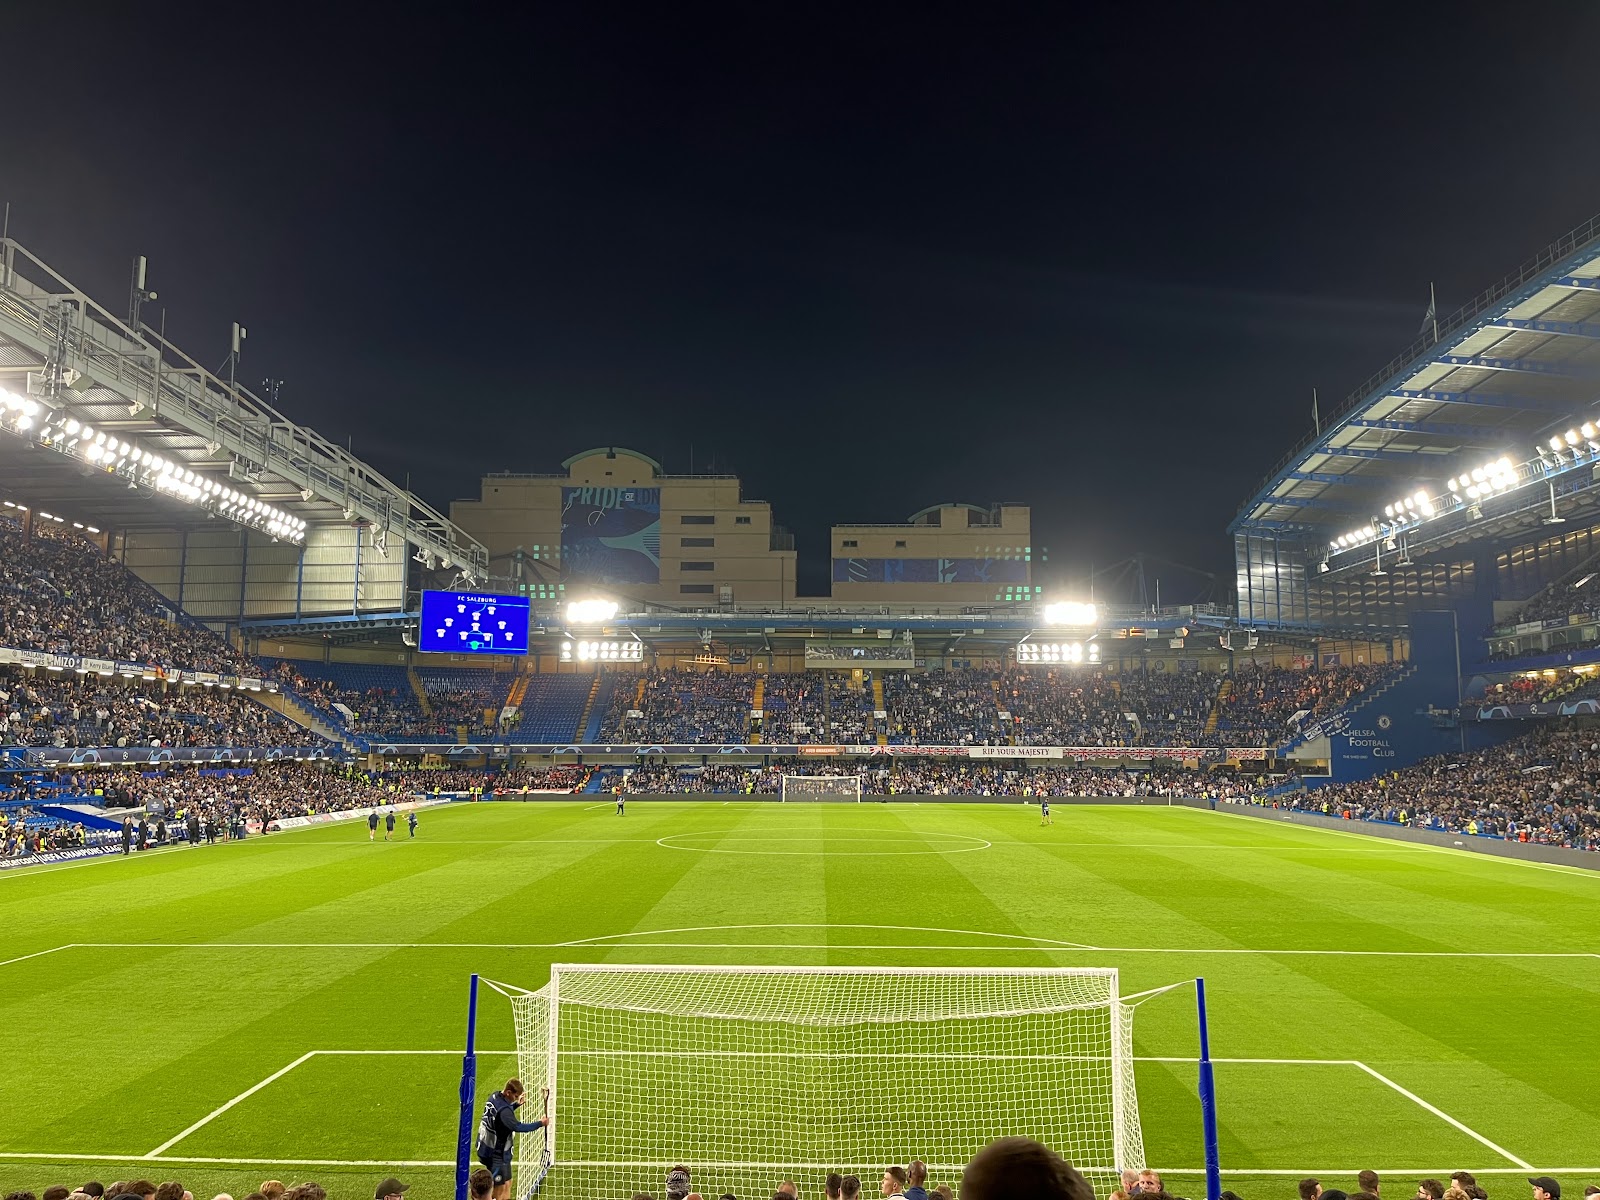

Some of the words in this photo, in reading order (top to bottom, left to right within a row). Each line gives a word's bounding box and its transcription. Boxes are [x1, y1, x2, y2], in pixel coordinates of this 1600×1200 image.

[568, 487, 626, 510] PRIDE
[625, 493, 634, 501] OF
[20, 650, 45, 660] THAILAND
[53, 655, 75, 668] MIZO
[89, 662, 101, 670] Kerry
[1320, 713, 1343, 726] CHELSEA
[1349, 737, 1390, 747] FOOTBALL
[1018, 748, 1050, 757] MAJESTY
[1373, 747, 1395, 757] CLUB
[40, 853, 64, 862] UEFA
[62, 847, 103, 860] CHAMPIONS
[102, 845, 122, 854] LEAG
